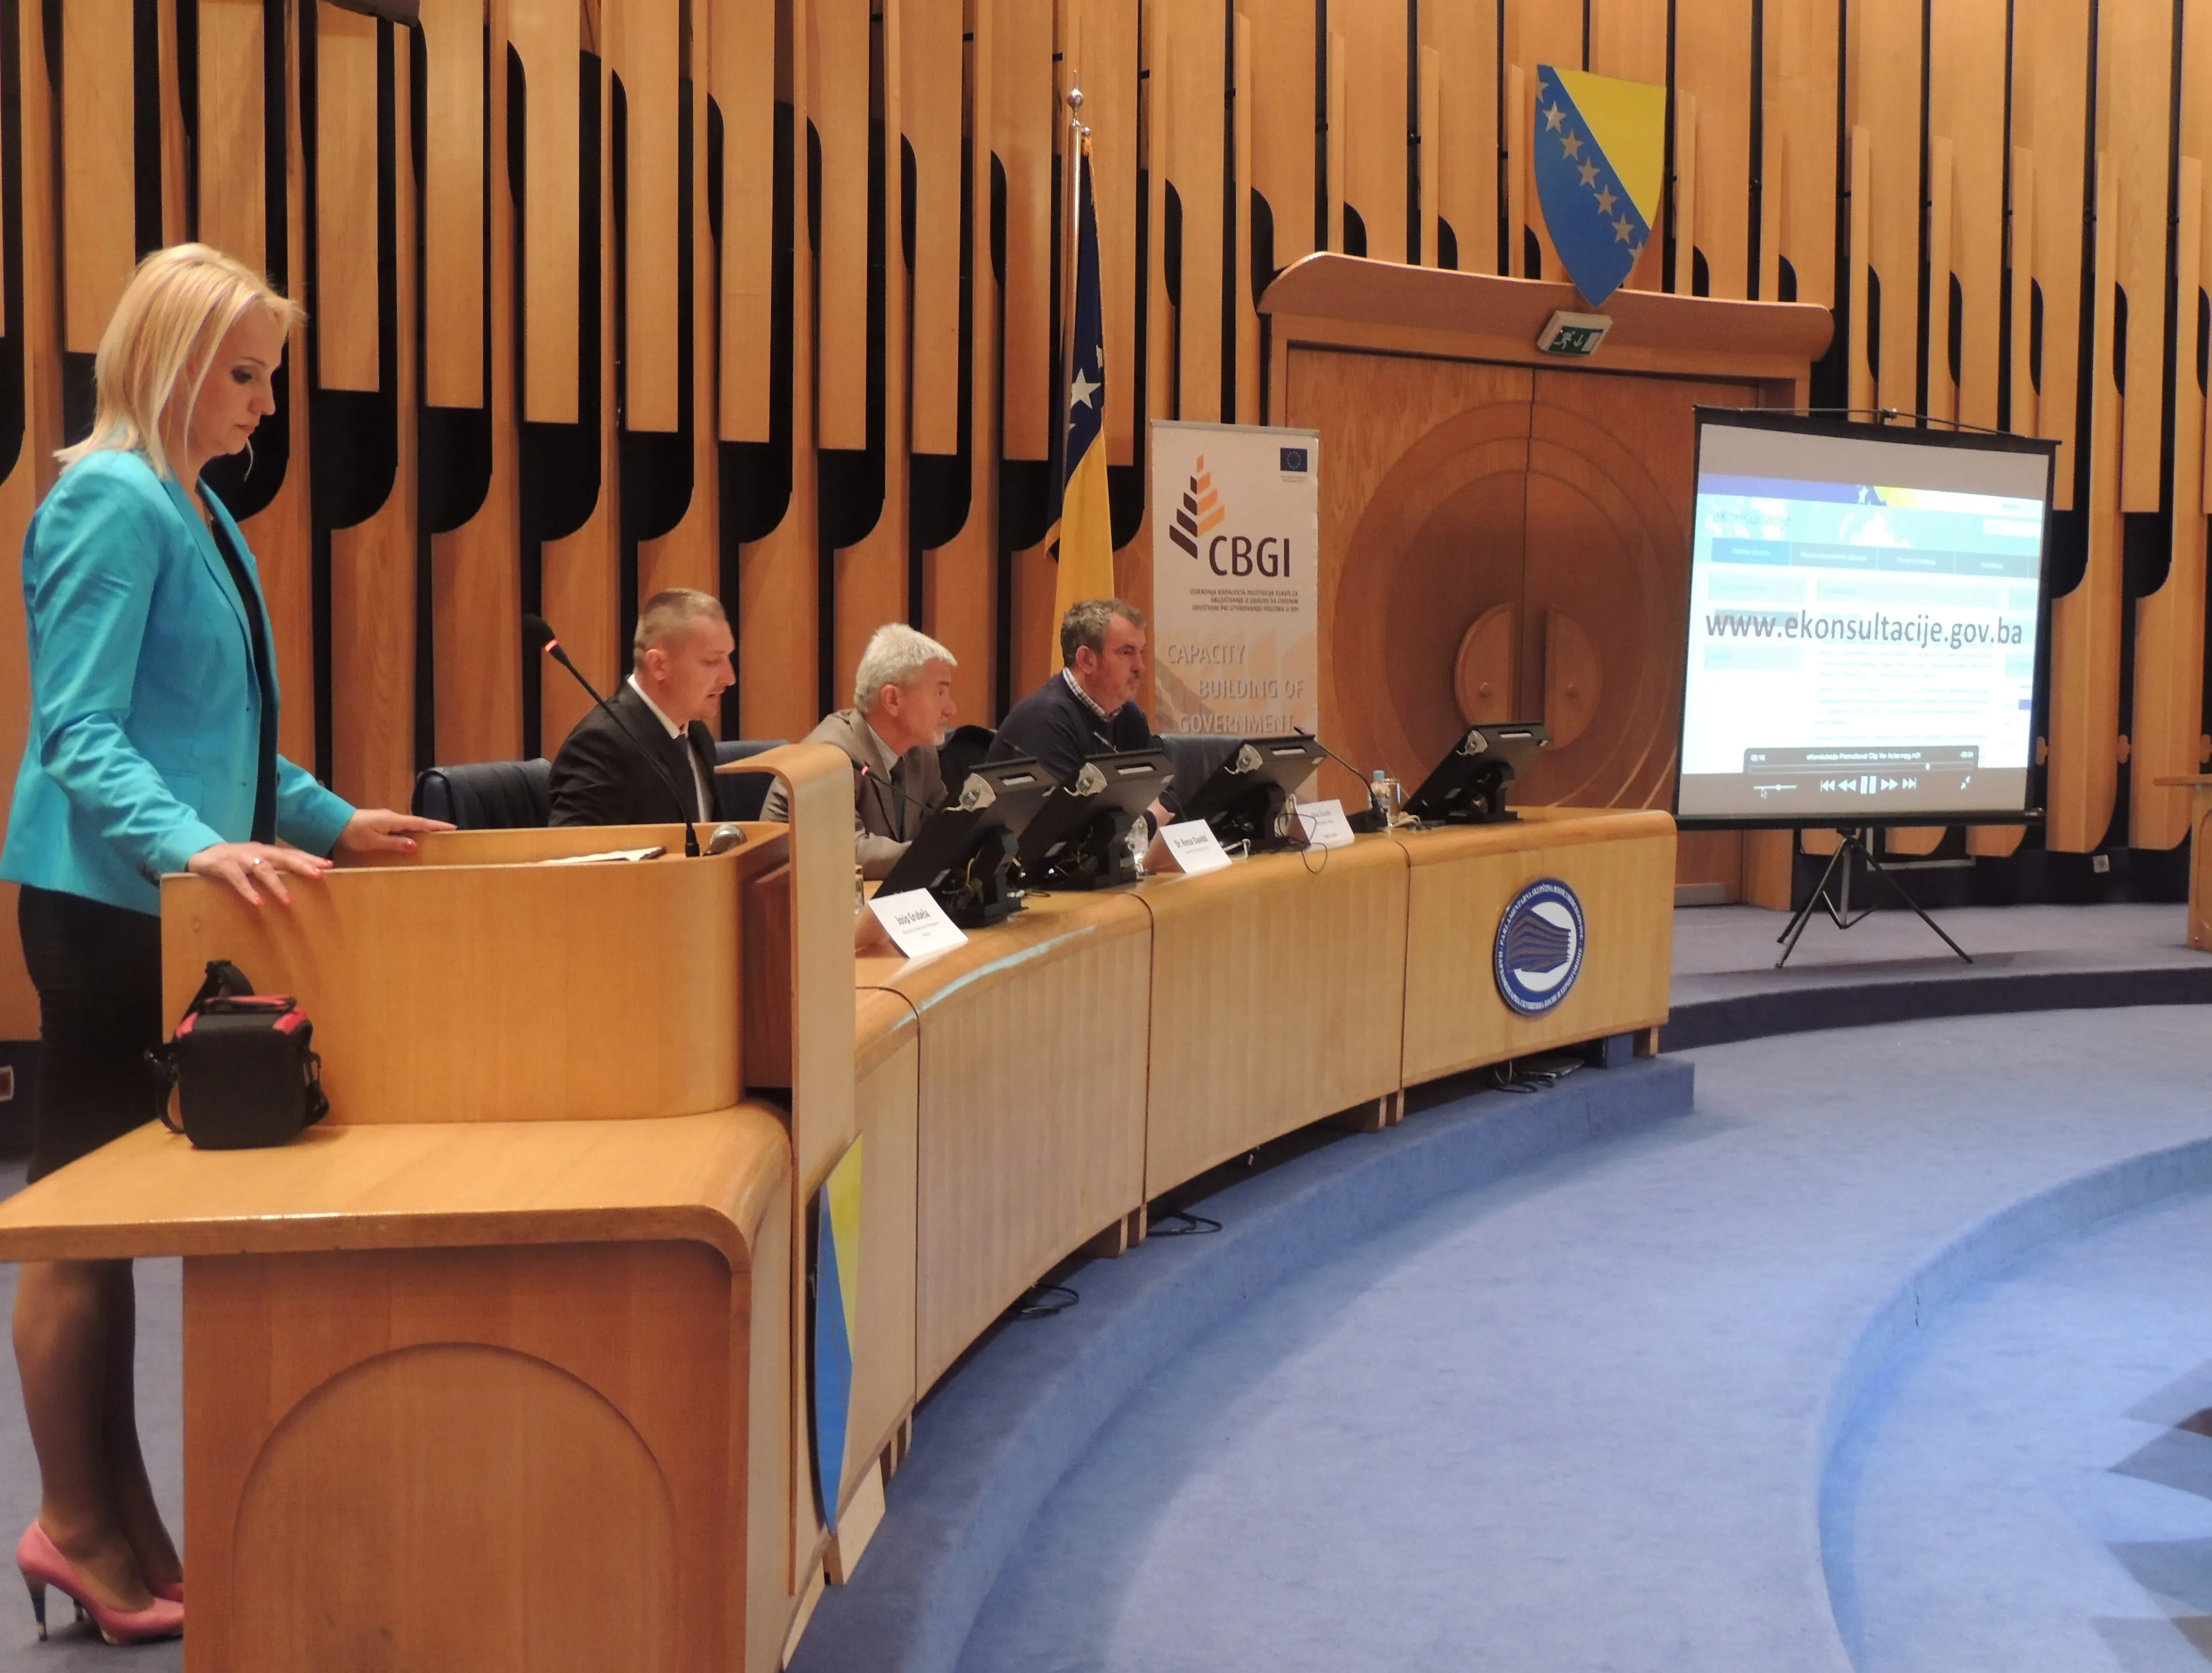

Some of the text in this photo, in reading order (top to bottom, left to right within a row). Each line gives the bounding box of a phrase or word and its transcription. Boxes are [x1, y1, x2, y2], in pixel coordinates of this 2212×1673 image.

[1209, 535, 1290, 577] CBGI
[1705, 609, 2022, 650] www.ekonsultacije.gov.ba
[1168, 644, 1246, 664] CAPACITY
[1199, 680, 1304, 699] BUILDING OF
[1180, 713, 1294, 734] GOVERNMENT
